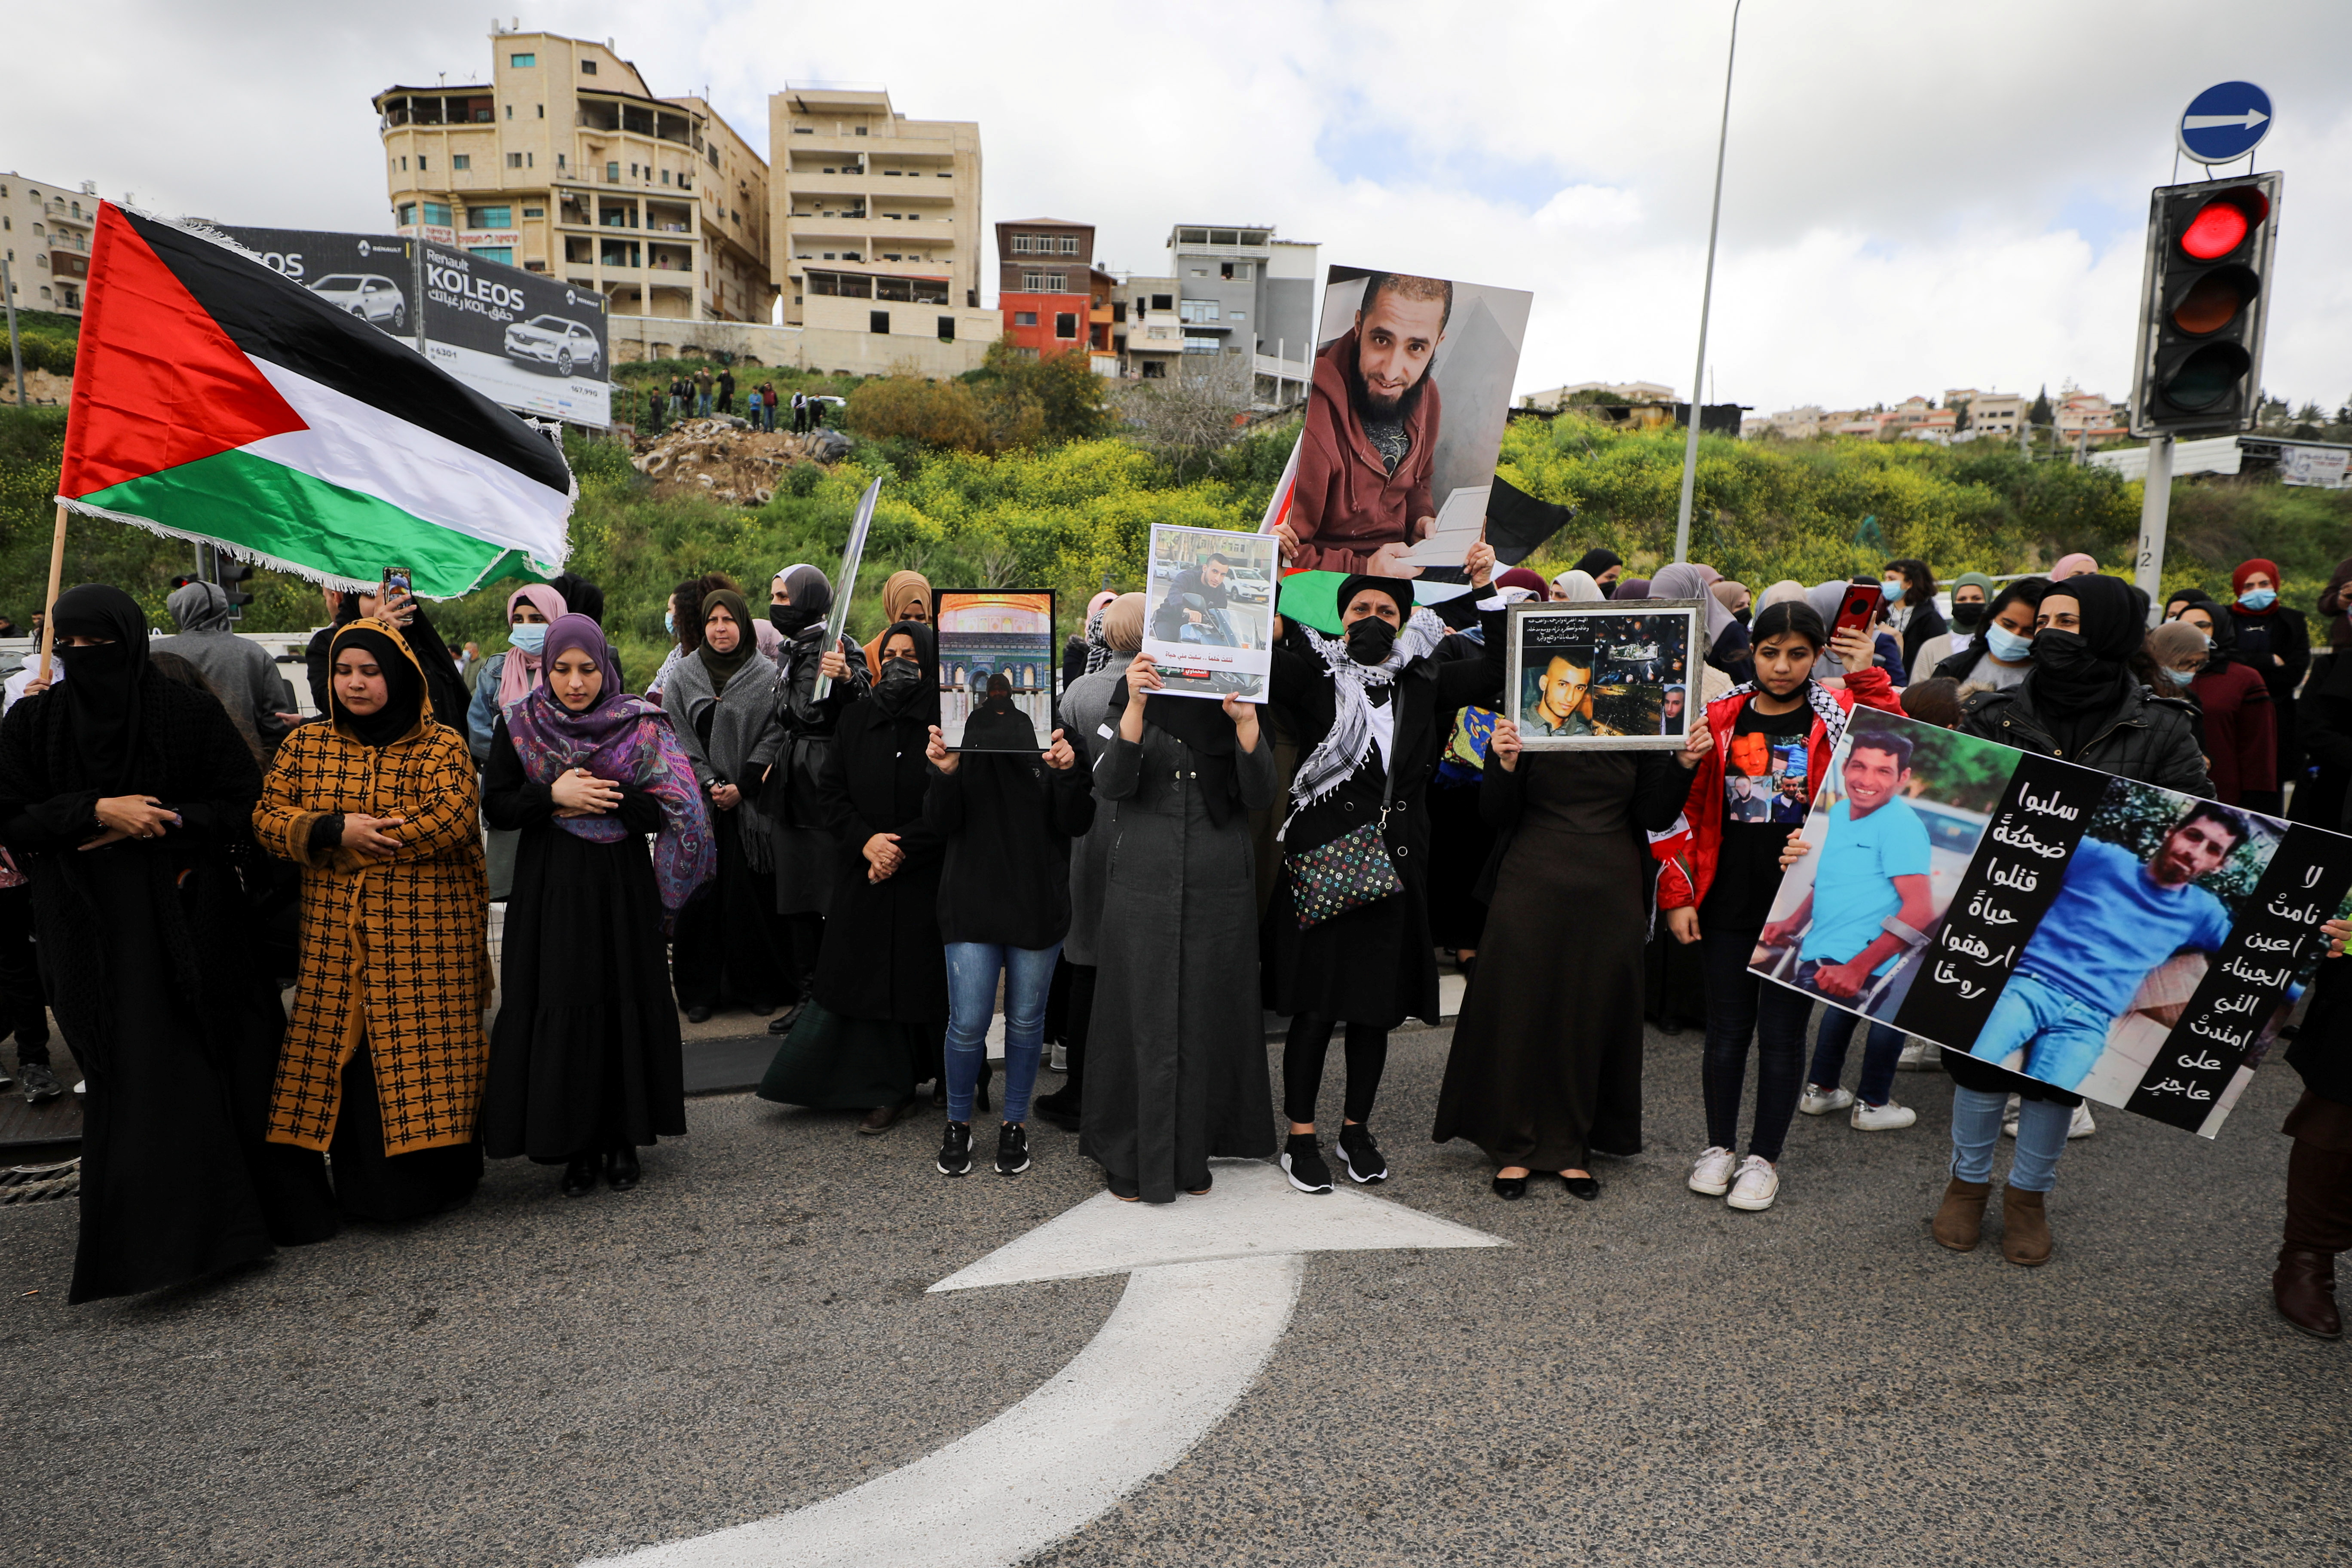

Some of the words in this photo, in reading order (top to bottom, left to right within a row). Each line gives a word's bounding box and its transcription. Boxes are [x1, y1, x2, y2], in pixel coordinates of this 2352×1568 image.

[426, 248, 469, 272] Renault
[426, 263, 525, 311] KOLEOS
[488, 306, 514, 322] حقق
[577, 297, 600, 308] RENAULT
[2018, 782, 2079, 821] سلبوا
[2300, 865, 2324, 888] لا
[1942, 924, 2016, 968] ارهقوا
[2245, 933, 2306, 958] أعين
[2221, 956, 2291, 990] الجبناء
[2214, 995, 2260, 1016] التي
[2177, 1050, 2221, 1070] على
